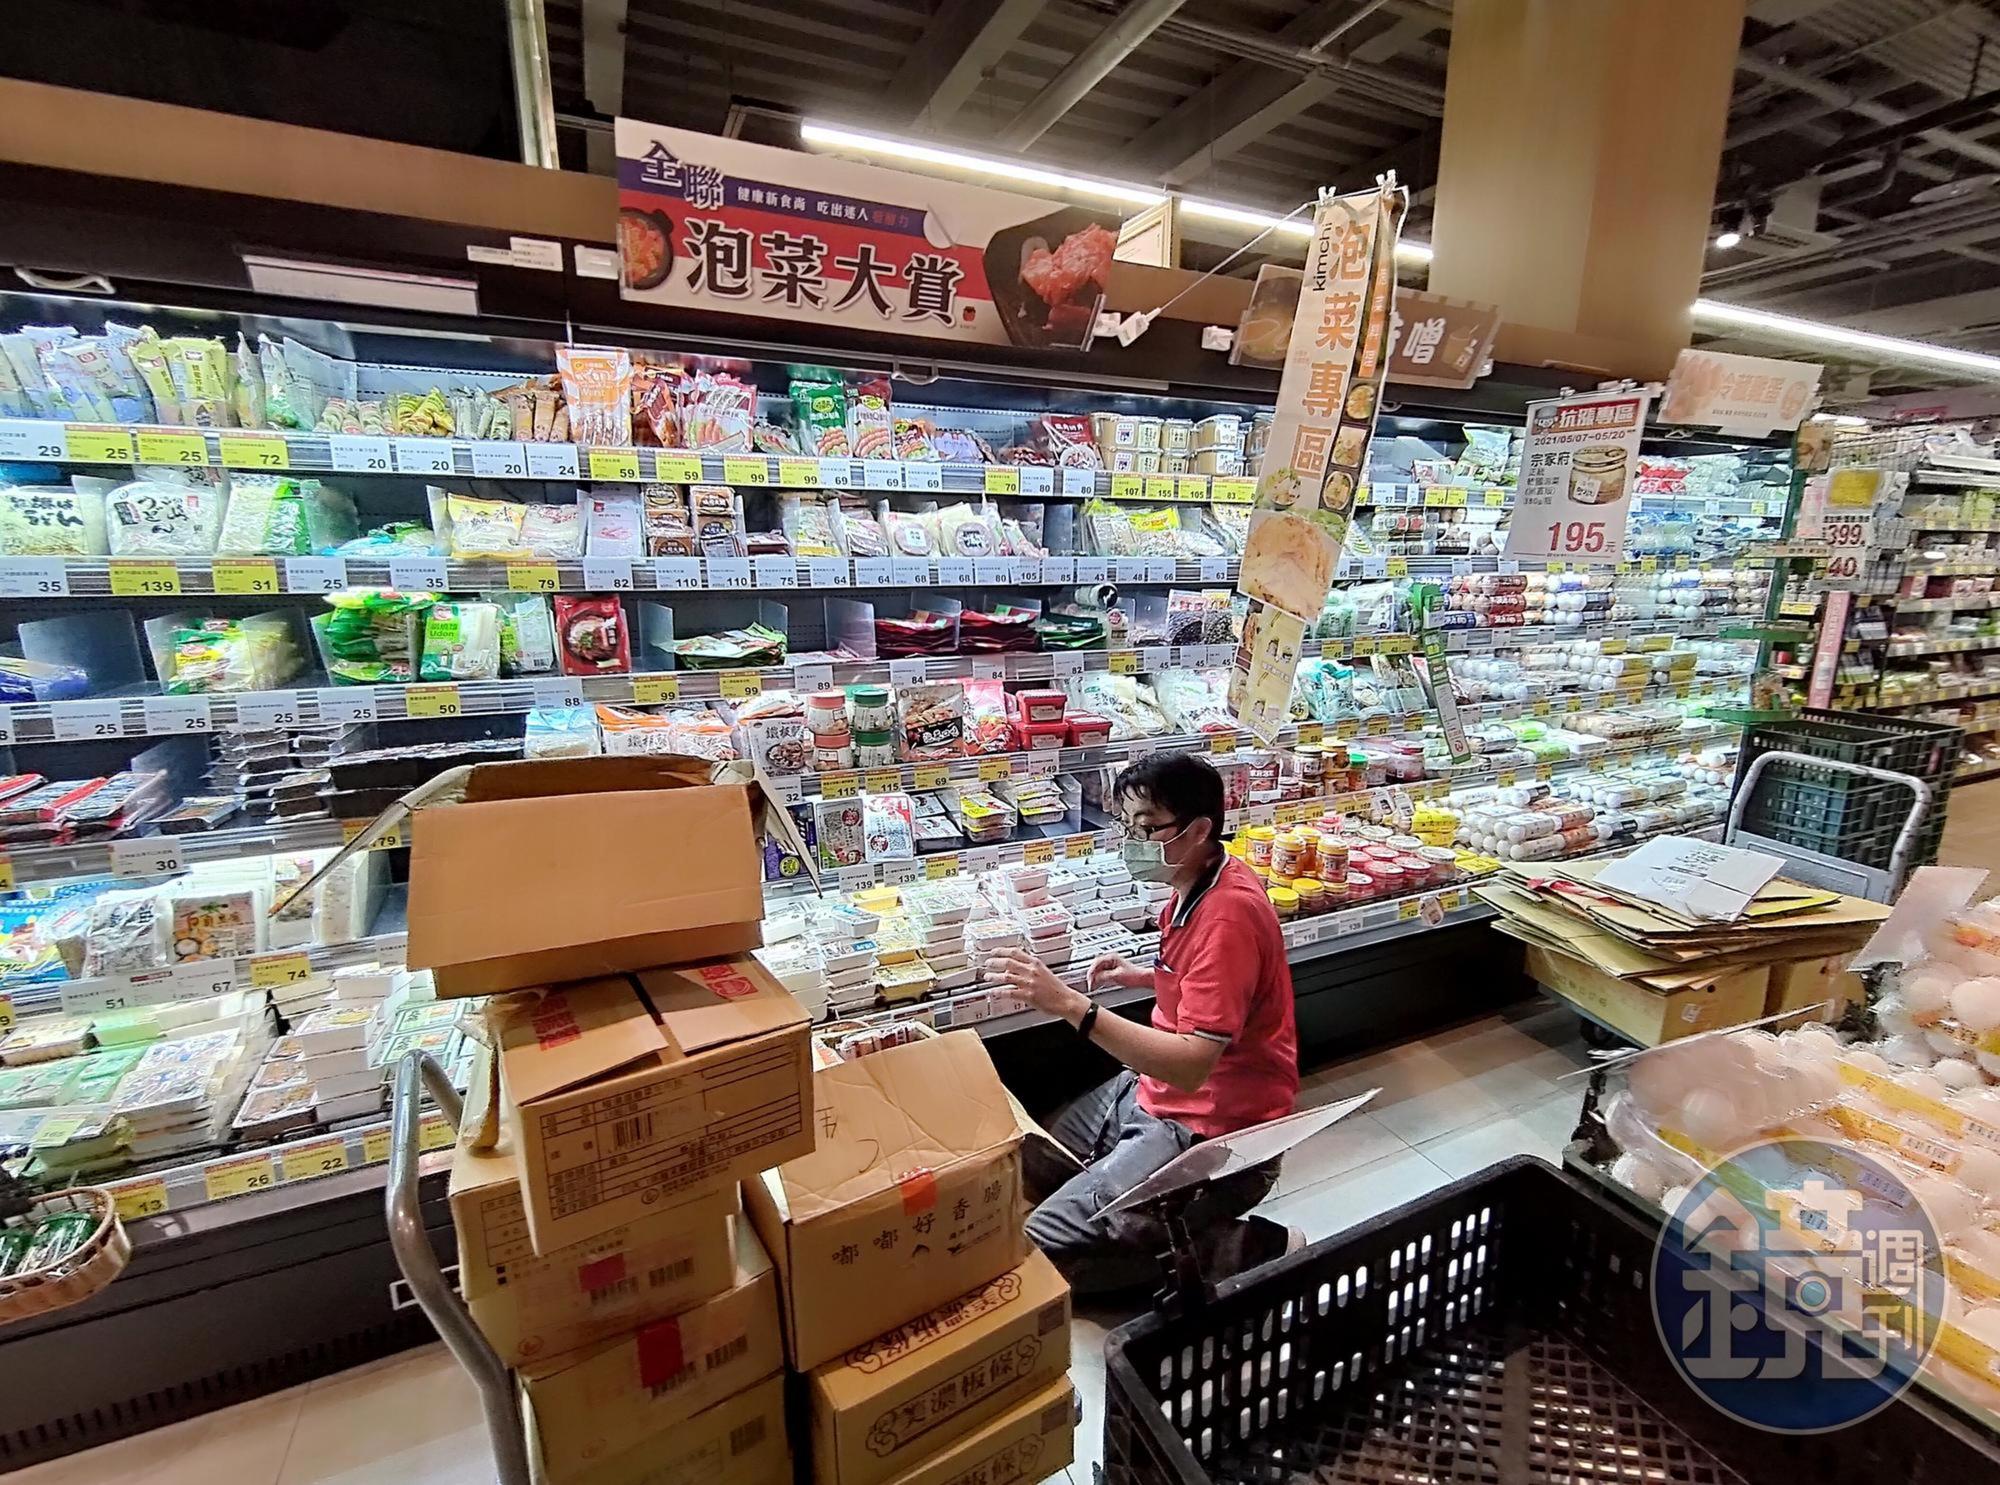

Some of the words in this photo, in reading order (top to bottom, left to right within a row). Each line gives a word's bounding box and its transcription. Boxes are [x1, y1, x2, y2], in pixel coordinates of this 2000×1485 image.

[640, 139, 725, 211] 全聯
[737, 186, 806, 212] 健康新食尚
[817, 201, 869, 222] 吃出迷人
[1313, 222, 1332, 292] kimchi
[683, 217, 965, 328] 泡菜大賞
[1290, 219, 1371, 480] 泡菜專區
[38, 445, 61, 457] 29
[105, 448, 128, 459] 25
[179, 451, 201, 462] 25
[259, 454, 282, 465] 72
[1531, 450, 1570, 468] 宗家府
[367, 458, 386, 469] 20
[432, 460, 449, 471] 20
[505, 464, 521, 474] 20
[558, 465, 575, 475] 24
[620, 468, 635, 478] 59
[684, 471, 699, 481] 59
[750, 473, 765, 483] 99
[804, 475, 817, 485] 99
[835, 476, 848, 485] 69
[886, 478, 899, 487] 69
[927, 480, 939, 488] 69
[1005, 483, 1016, 491] 70
[1039, 484, 1050, 493] 80
[1081, 486, 1092, 494] 80
[1125, 488, 1139, 496] 107
[1158, 490, 1172, 498] 155
[1190, 491, 1204, 499] 105
[834, 576, 847, 585] 64
[878, 575, 890, 584] 64
[915, 575, 927, 583] 68
[959, 574, 970, 583] 68
[995, 574, 1006, 582] 80
[1021, 572, 1037, 580] 105
[1060, 574, 1071, 582] 85
[1164, 573, 1173, 581] 66
[38, 581, 62, 592] 35
[141, 581, 173, 592] 139
[252, 580, 271, 591] 31
[323, 579, 342, 589] 25
[426, 578, 444, 588] 35
[538, 579, 555, 589] 79
[614, 579, 630, 588] 82
[675, 578, 698, 587] 110
[727, 577, 747, 586] 110
[780, 577, 794, 586] 75
[428, 629, 455, 638] Udon
[992, 671, 1003, 679] 84
[1072, 666, 1083, 675] 82
[912, 676, 923, 684] 84
[745, 687, 758, 695] 99
[817, 682, 830, 690] 89
[660, 691, 675, 701] 99
[564, 697, 580, 707] 88
[353, 709, 371, 719] 25
[439, 704, 456, 714] 50
[274, 713, 293, 723] 25
[185, 718, 206, 729] 25
[95, 723, 117, 735] 25
[997, 770, 1008, 779] 79
[1041, 765, 1057, 774] 149
[935, 777, 947, 786] 69
[837, 786, 856, 796] 115
[881, 783, 899, 792] 115
[786, 793, 800, 802] 32
[1037, 853, 1052, 863] 140
[156, 859, 177, 871] 30
[986, 862, 996, 870] 82
[945, 868, 957, 877] 83
[898, 874, 915, 883] 139
[855, 880, 873, 889] 139
[287, 970, 307, 981] 74
[212, 981, 231, 993] 67
[106, 998, 124, 1009] 51
[321, 1158, 343, 1170] 22
[247, 1174, 269, 1187] 26
